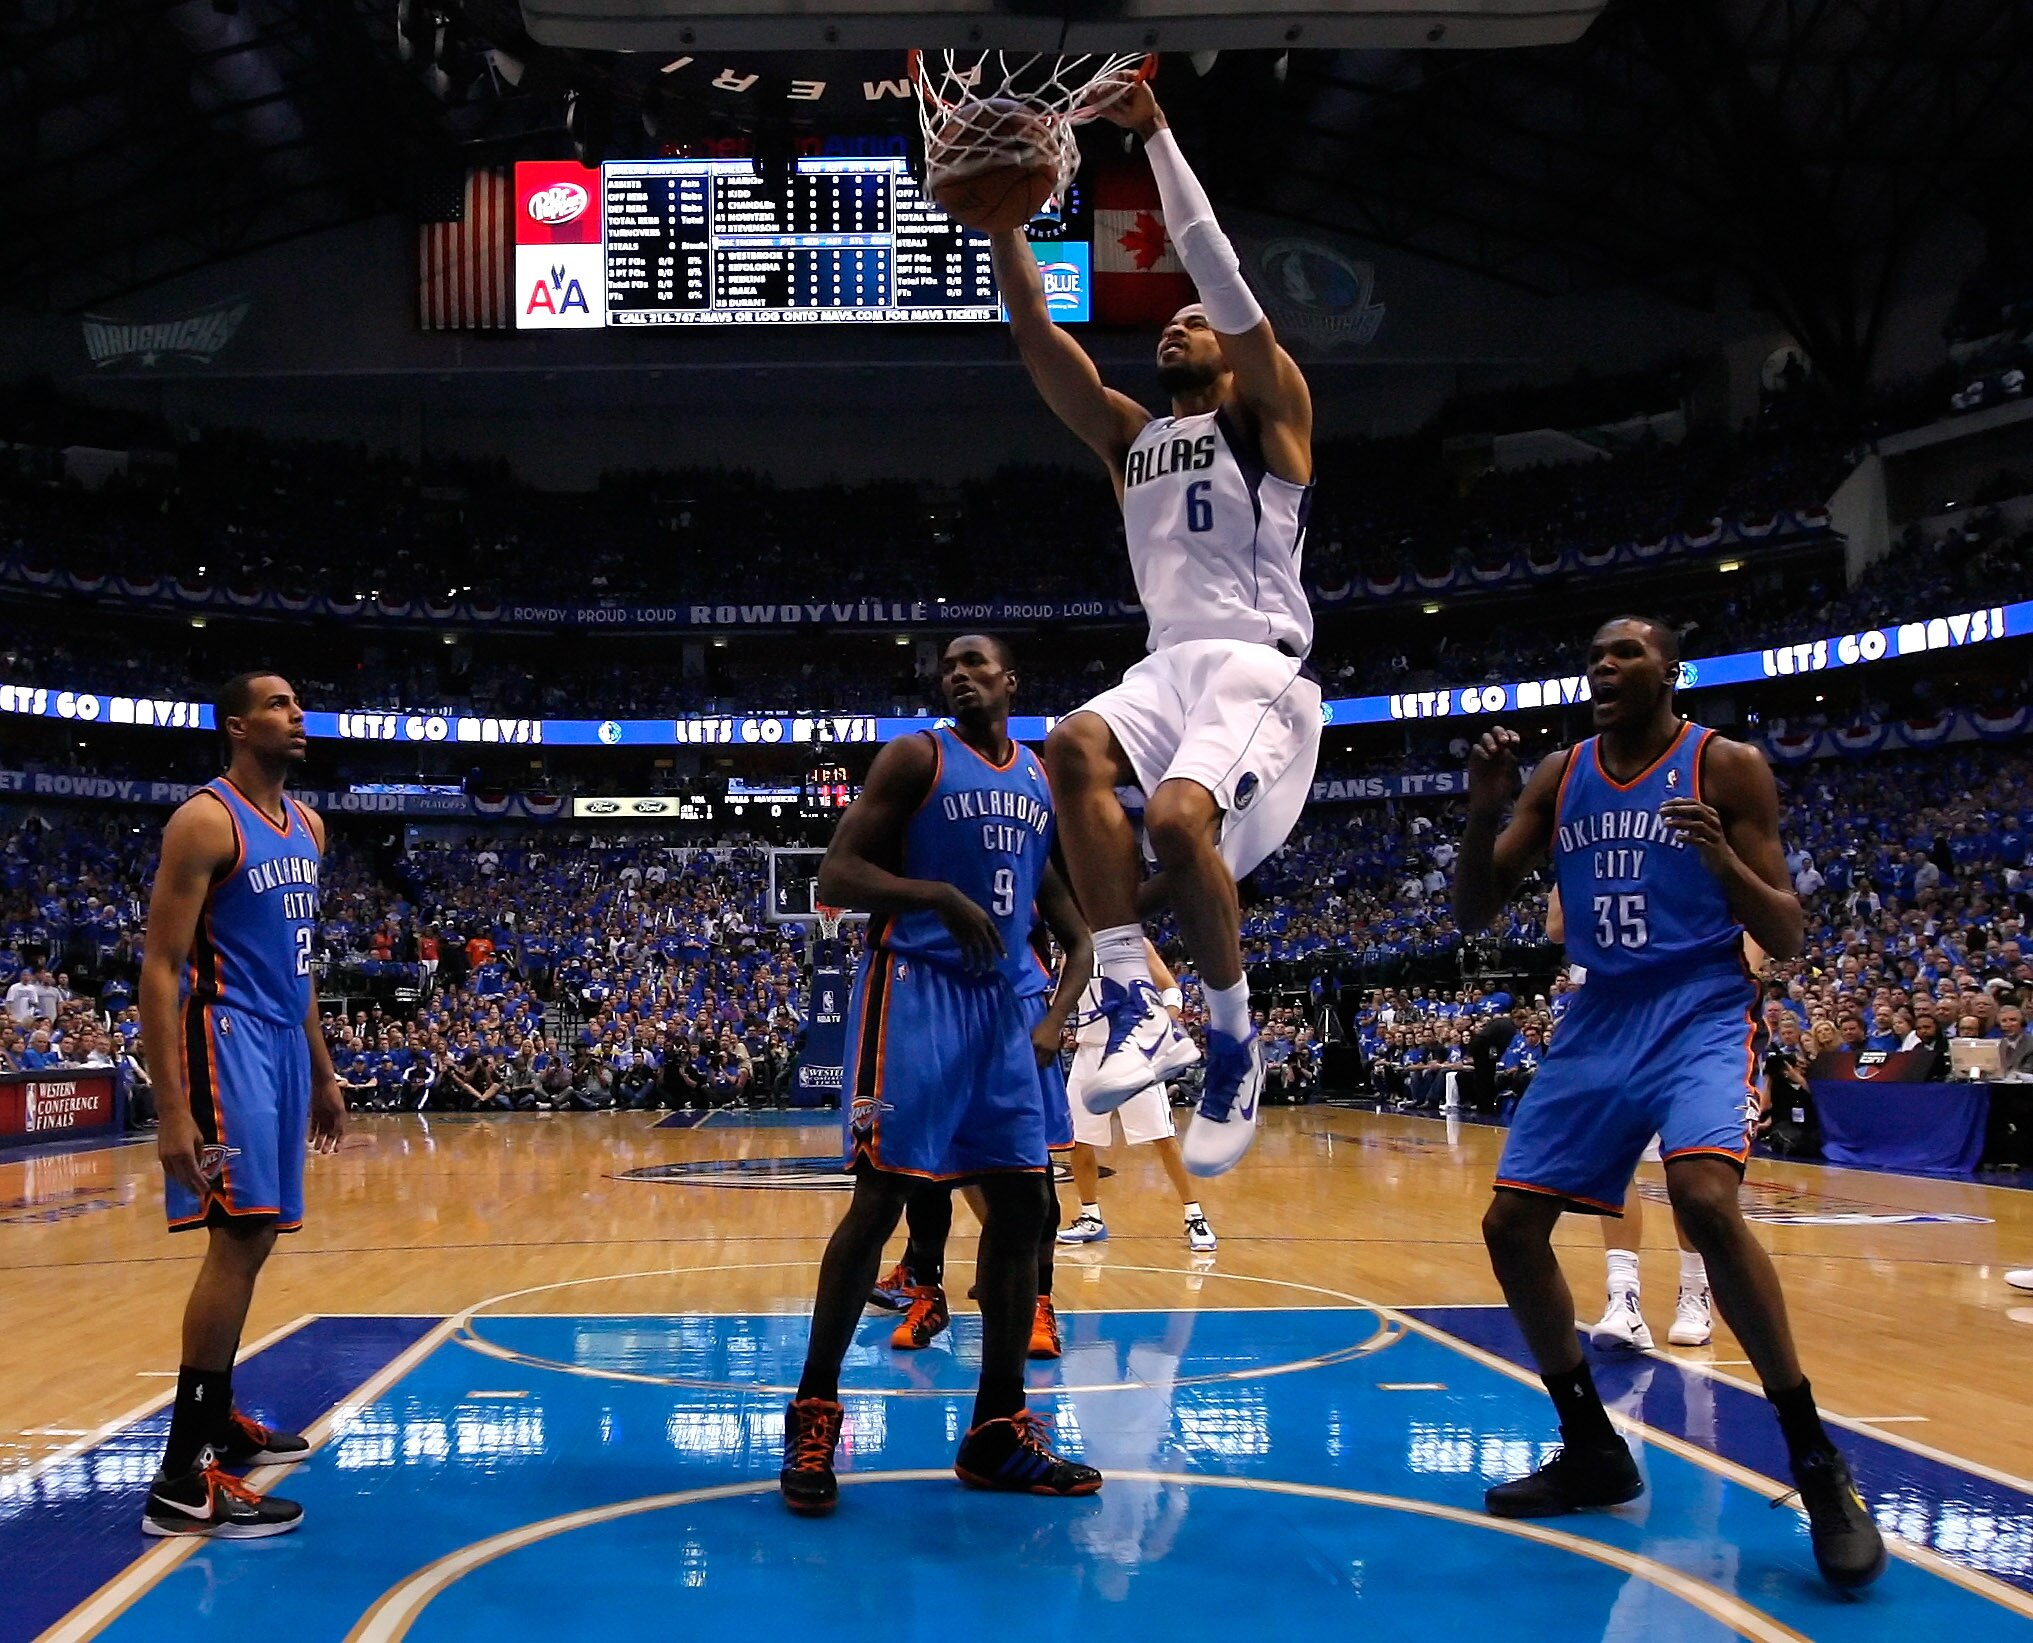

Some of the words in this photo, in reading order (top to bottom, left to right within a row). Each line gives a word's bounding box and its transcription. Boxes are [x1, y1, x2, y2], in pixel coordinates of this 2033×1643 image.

[727, 189, 751, 199] KIDD
[607, 216, 636, 225] TOTAL
[727, 223, 780, 233] STEVENSON
[896, 212, 925, 222] TOTAL
[1044, 273, 1081, 294] BLUE
[728, 298, 767, 307] DURANT
[619, 312, 648, 323] CALL
[735, 311, 753, 322] OR
[754, 311, 780, 322] LOG
[782, 311, 819, 322] ONTO
[820, 310, 884, 321] MAVS.COM
[886, 309, 909, 320] FOR
[910, 309, 944, 320] MAVS
[945, 309, 991, 320] TICKETS
[1186, 480, 1214, 533] 6
[513, 607, 568, 622] ROWDY
[577, 609, 627, 623] PROUD
[637, 608, 677, 622] LOUD
[690, 604, 928, 624] ROWDYVILLE
[940, 604, 994, 619] ROWDY
[1003, 605, 1053, 619] PROUD
[1063, 602, 1103, 617] LOUD
[1761, 640, 1828, 678] LETS
[1836, 629, 1888, 665] GO
[1897, 606, 2006, 656] MAVS!
[56, 691, 101, 721] GO
[109, 696, 201, 729] MAVS!
[1390, 690, 1451, 720] LETS
[1460, 685, 1507, 715] GO
[338, 713, 398, 740] LETS
[404, 716, 449, 742] GO
[456, 717, 544, 744] MAVS!
[675, 718, 734, 744] LETS
[741, 718, 784, 744] GO
[791, 718, 878, 744] MAVS!
[34, 773, 143, 802] ROWDY,
[327, 793, 406, 812] LOUD!
[1313, 778, 1392, 800] FANS,
[1400, 773, 1454, 794] IT'S
[770, 804, 782, 818] 0
[942, 789, 1049, 835] OKLAHOMA
[982, 824, 1027, 856] CITY
[1594, 849, 1644, 879] CITY
[283, 892, 314, 919] CITY
[992, 868, 1014, 917] 9
[1593, 894, 1648, 949] 35
[296, 927, 312, 976] 2
[831, 1015, 841, 1024] TV
[1859, 1051, 1888, 1064] ESPN
[39, 1081, 77, 1099] WESTERN
[37, 1096, 99, 1116] CONFERENCE
[36, 1112, 75, 1131] FINALS
